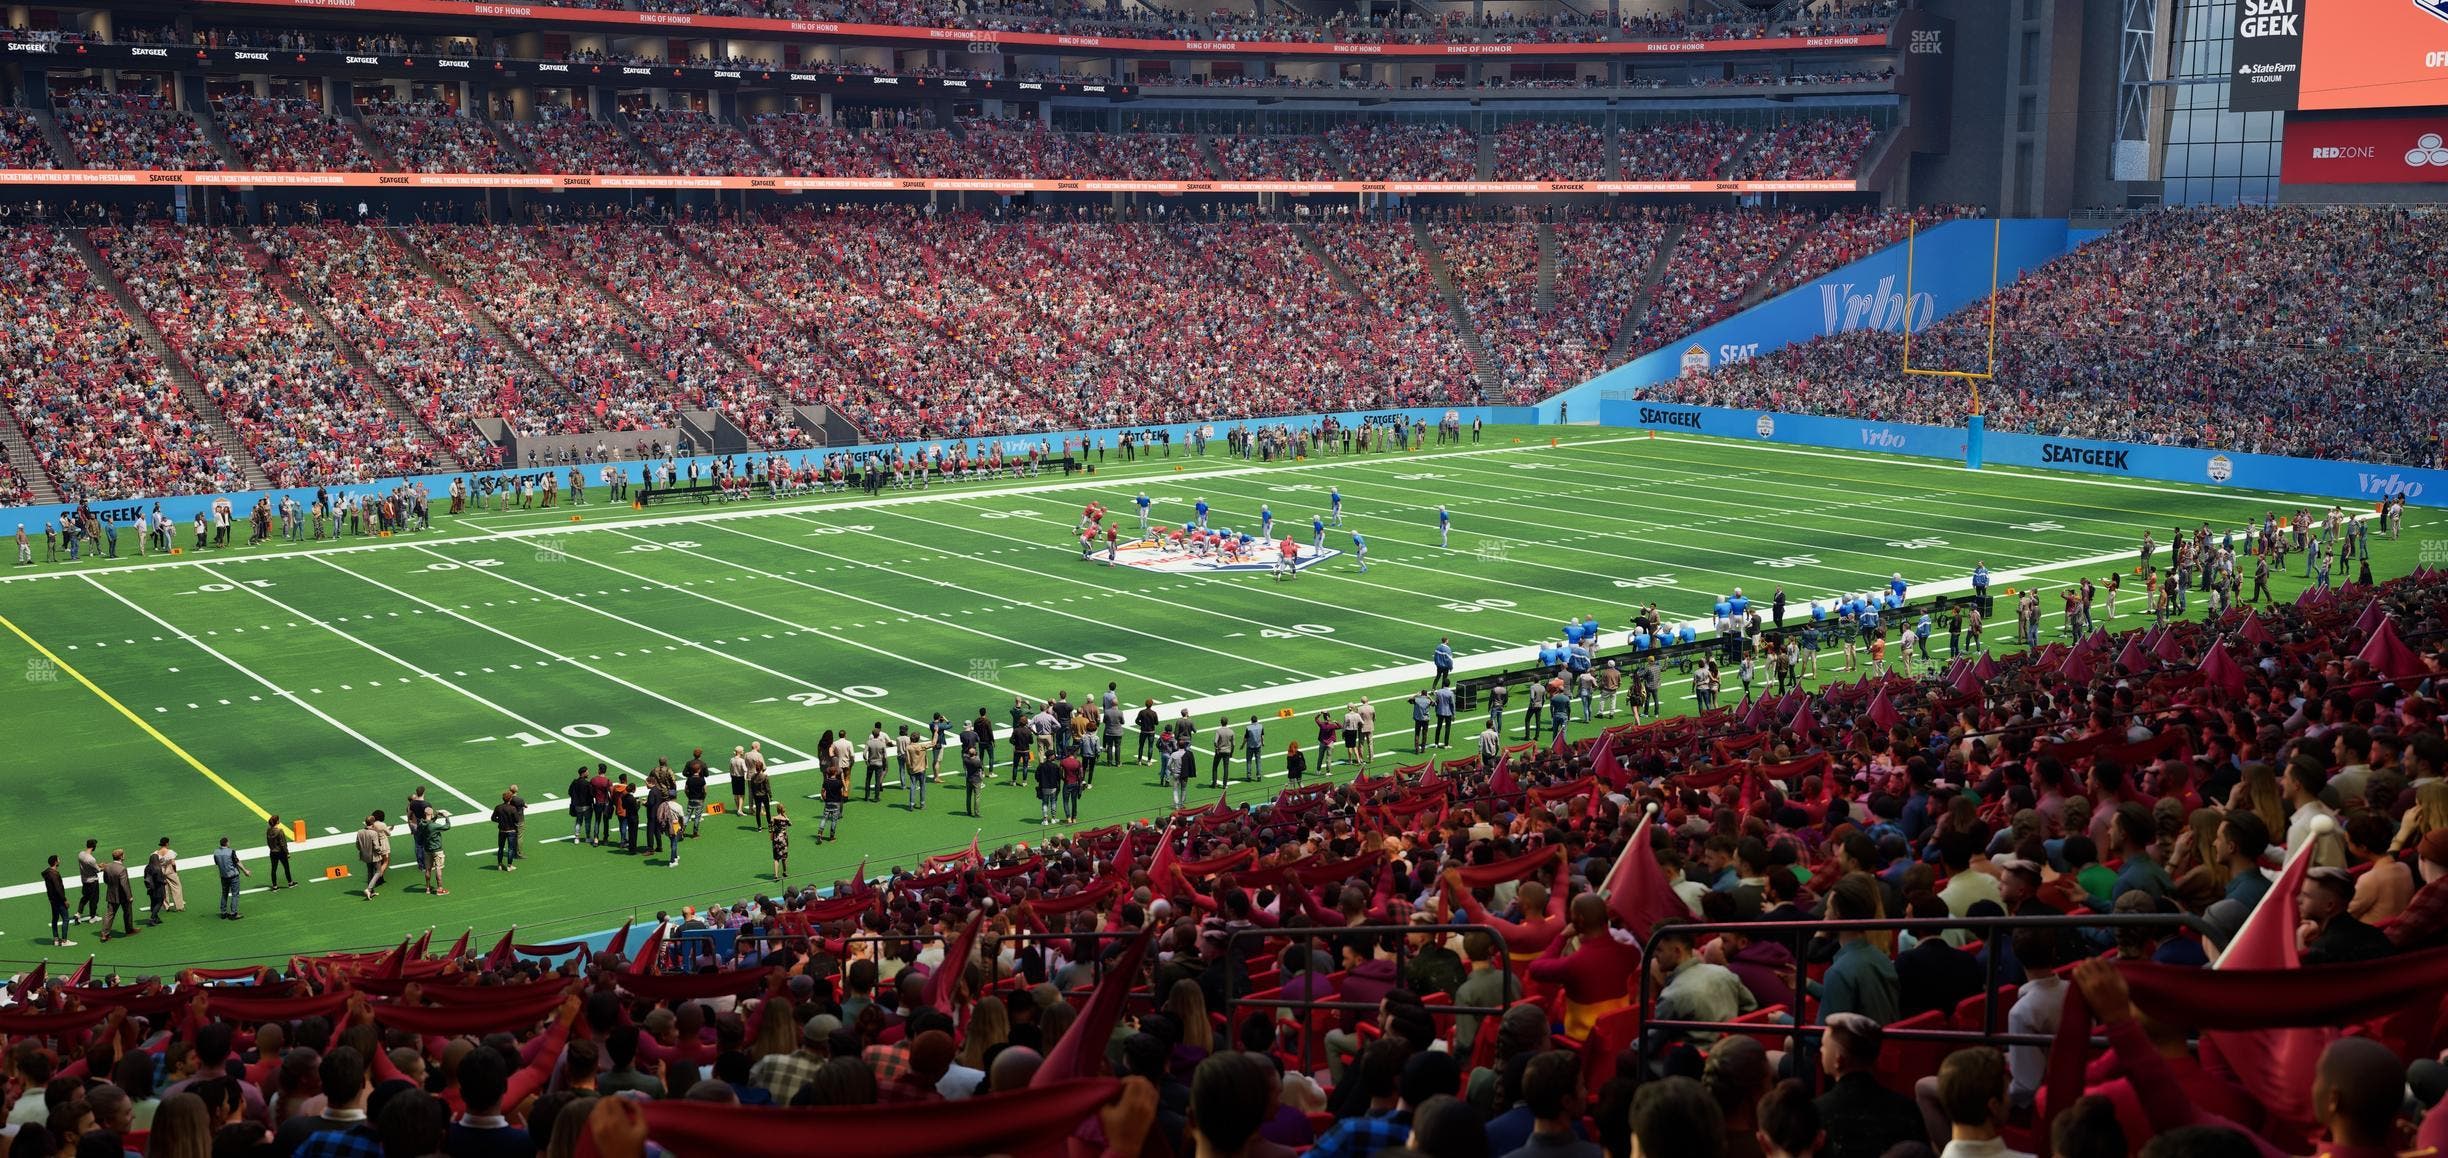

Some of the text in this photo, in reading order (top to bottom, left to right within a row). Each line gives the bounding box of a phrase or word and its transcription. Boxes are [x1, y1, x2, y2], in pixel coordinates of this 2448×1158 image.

[475, 5, 531, 15] RING OF HONOR
[2245, 0, 2293, 15] SEAT
[791, 22, 806, 30] RING
[2240, 14, 2299, 38] GEEK
[8, 43, 46, 52] SEATGEEK
[132, 48, 167, 56] SEATGEEK
[234, 52, 269, 60] SEATGEEK
[346, 56, 378, 64] SEATGEEK
[439, 60, 469, 68] SEATGEEK
[539, 63, 568, 71] SEATGEEK
[2252, 62, 2296, 74] State Farm
[2251, 75, 2282, 83] STADIUM
[2312, 146, 2375, 159] REDZONE
[150, 174, 183, 182] SEATGEEK
[379, 176, 409, 184] SEATGEEK
[1820, 274, 1934, 337] Vrbo
[1720, 343, 1759, 367] SEAT
[1639, 407, 1701, 429] SEATGEEK
[1861, 428, 1906, 448] Vrbo
[2042, 444, 2129, 470] SEATGEEK
[2358, 473, 2423, 498] Vrbo
[1753, 556, 1821, 568] 30
[1612, 576, 1678, 588] 40
[1437, 599, 1517, 612] 50
[1260, 624, 1335, 639] 40
[1035, 653, 1127, 671] 30
[787, 685, 889, 707] 20
[505, 724, 611, 747] 10
[712, 805, 721, 813] 10
[335, 868, 341, 877] G
